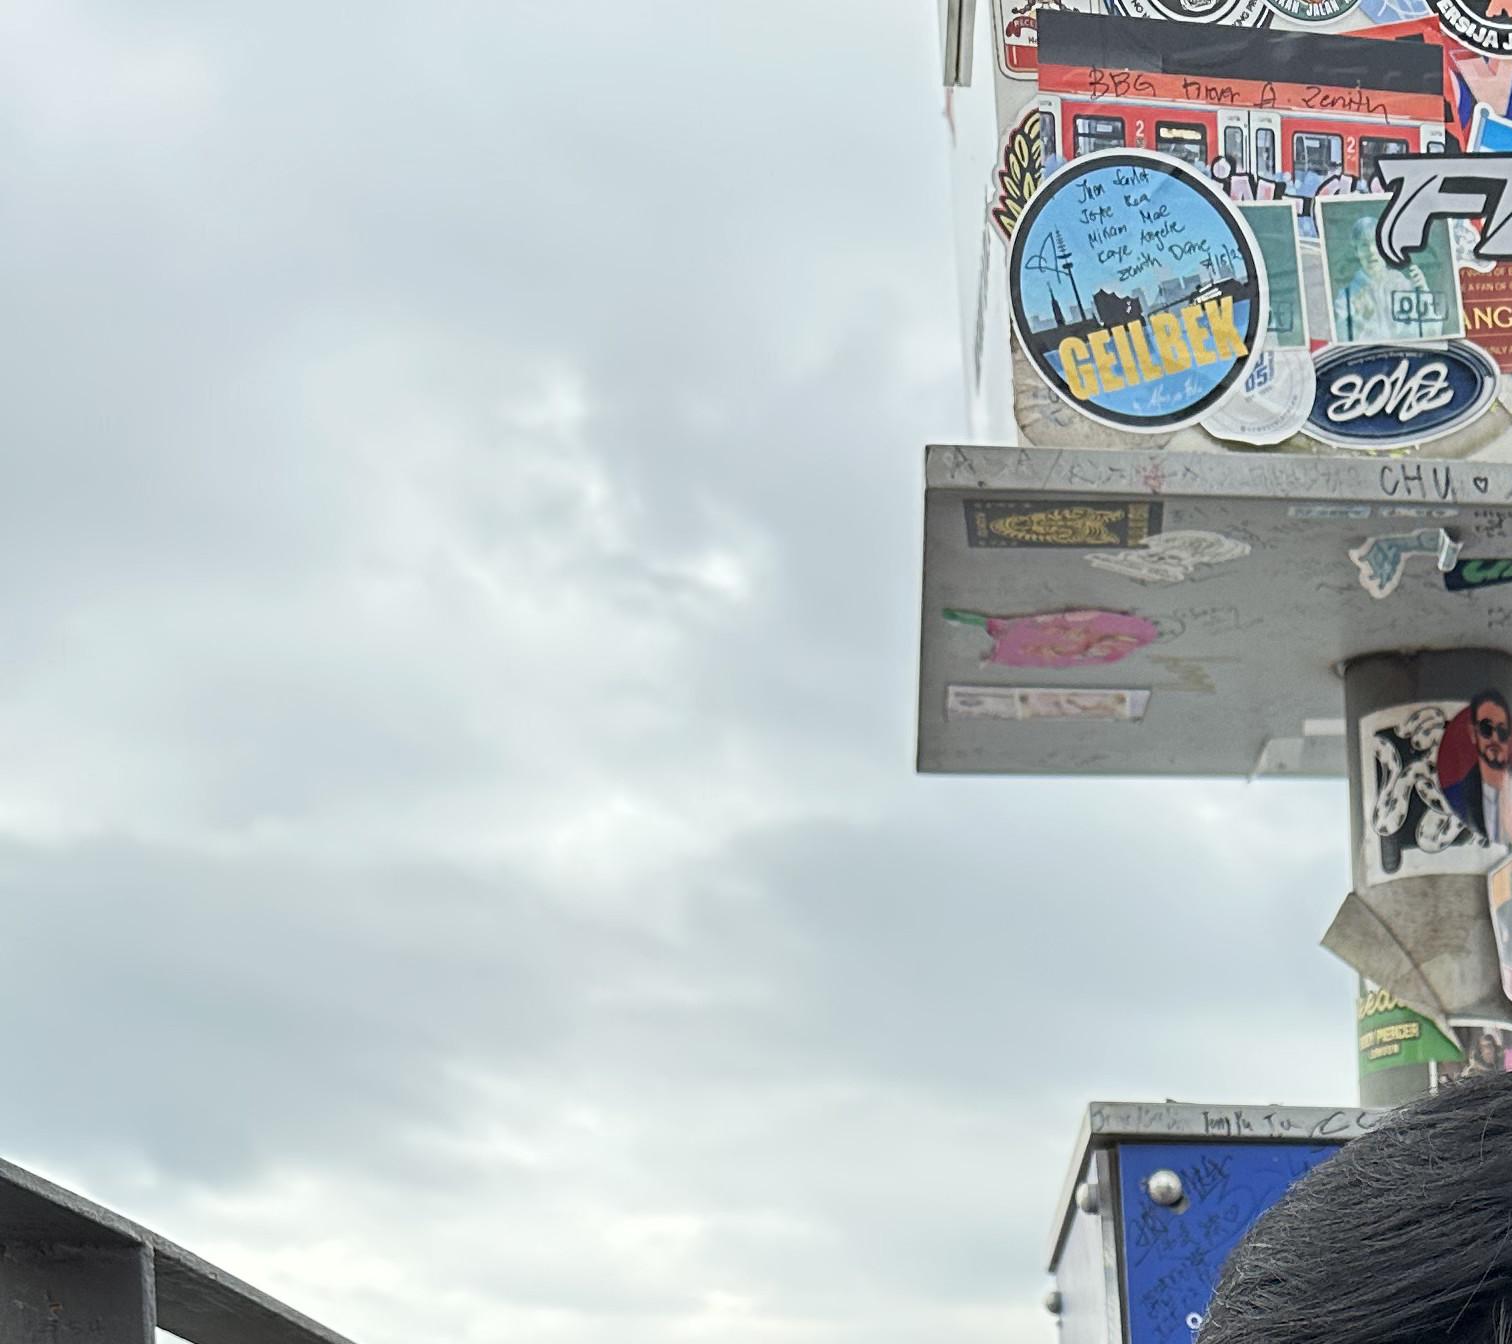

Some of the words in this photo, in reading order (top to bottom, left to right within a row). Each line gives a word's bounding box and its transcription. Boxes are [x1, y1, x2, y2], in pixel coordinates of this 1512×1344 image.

[1136, 120, 1145, 138] 2
[1346, 136, 1356, 153] 2
[1058, 294, 1249, 402] GEILBEK
[1380, 464, 1456, 501] CHU
